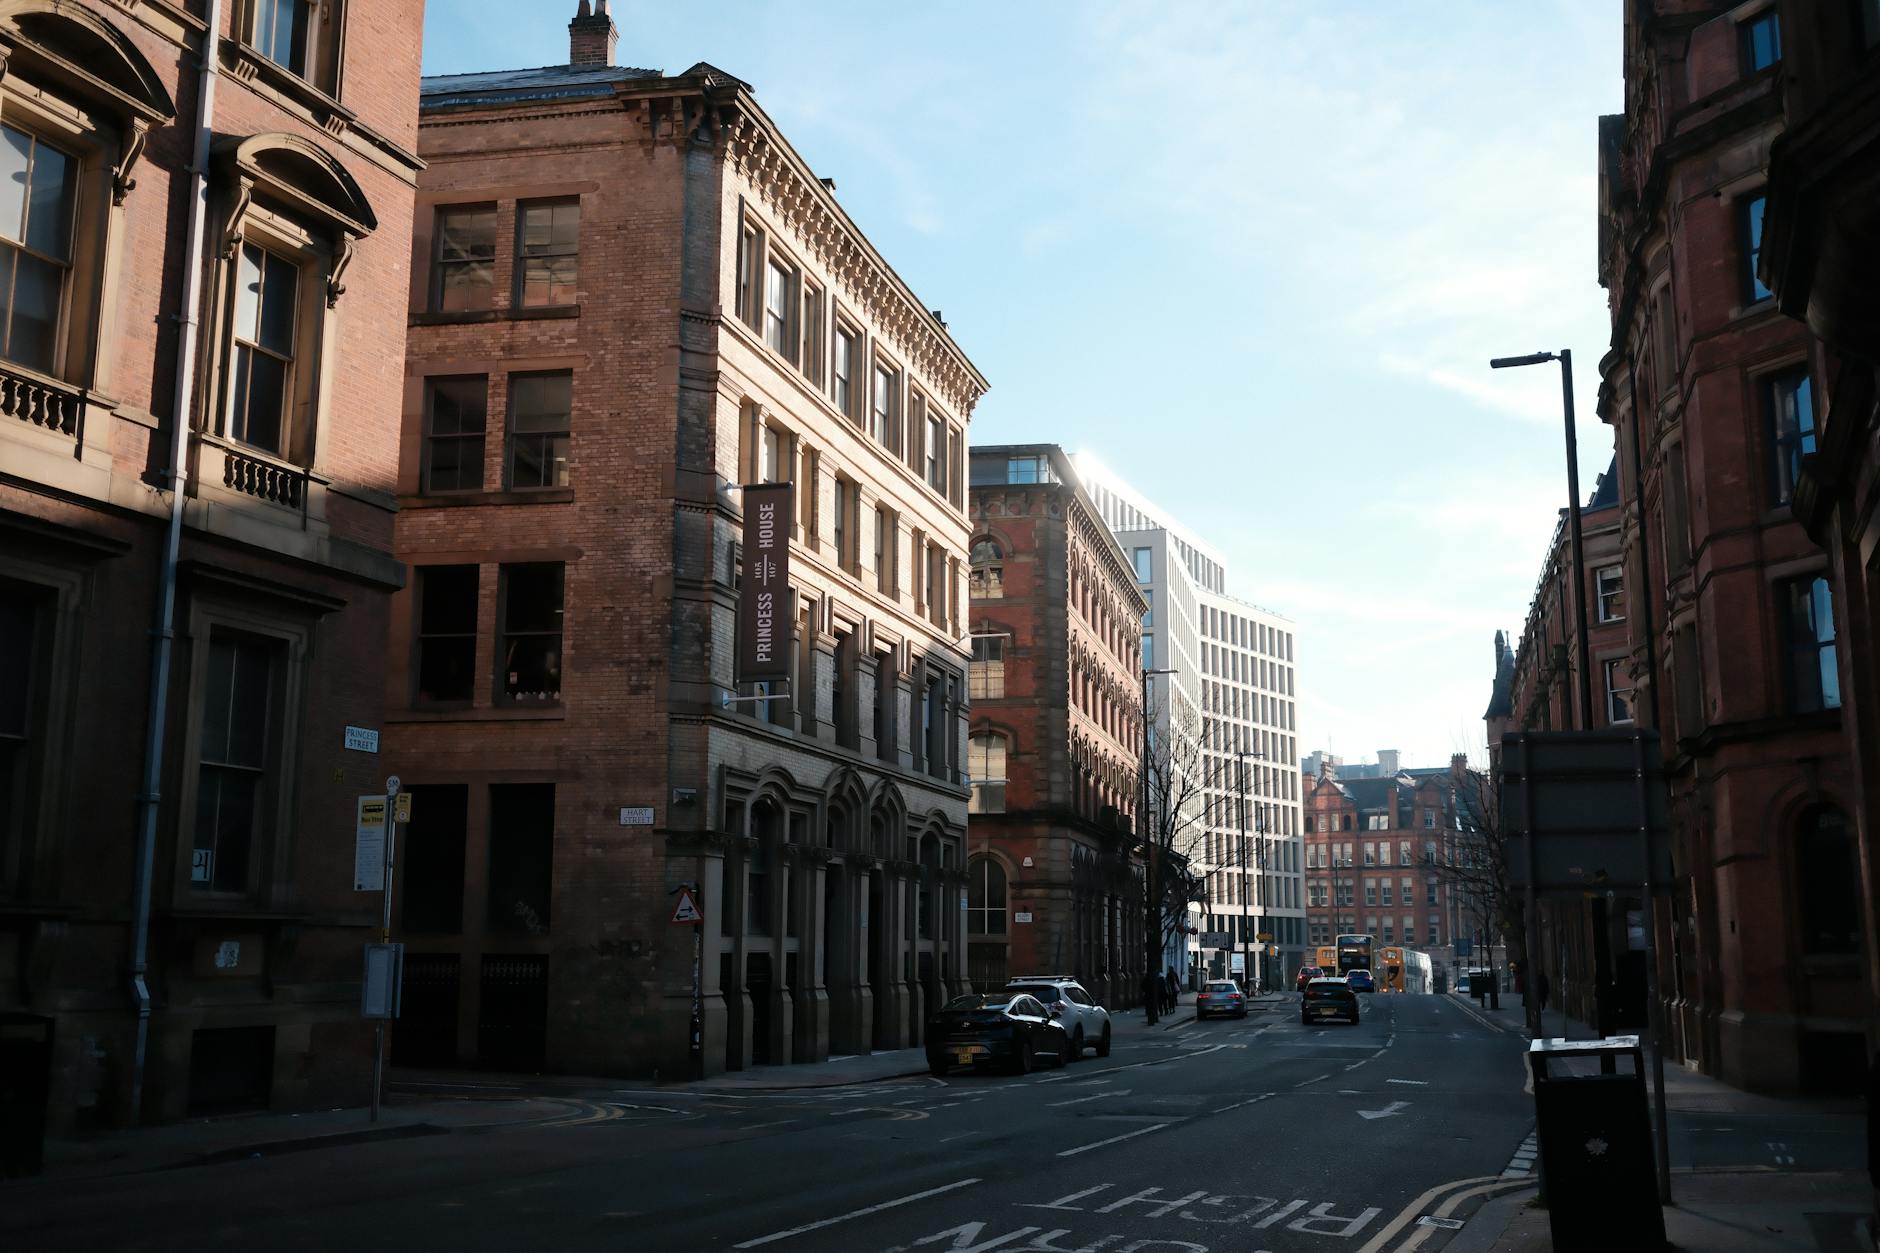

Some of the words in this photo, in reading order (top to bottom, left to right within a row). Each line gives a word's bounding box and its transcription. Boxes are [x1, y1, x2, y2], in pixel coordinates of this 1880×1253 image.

[759, 503, 774, 548] HOUSE
[754, 562, 763, 579] 105
[769, 562, 777, 579] 107
[757, 593, 772, 662] PRINCESS
[347, 727, 377, 741] PRINCESS
[348, 738, 374, 749] STREET
[624, 816, 651, 824] STREET
[1011, 1183, 1383, 1237] RIGHT
